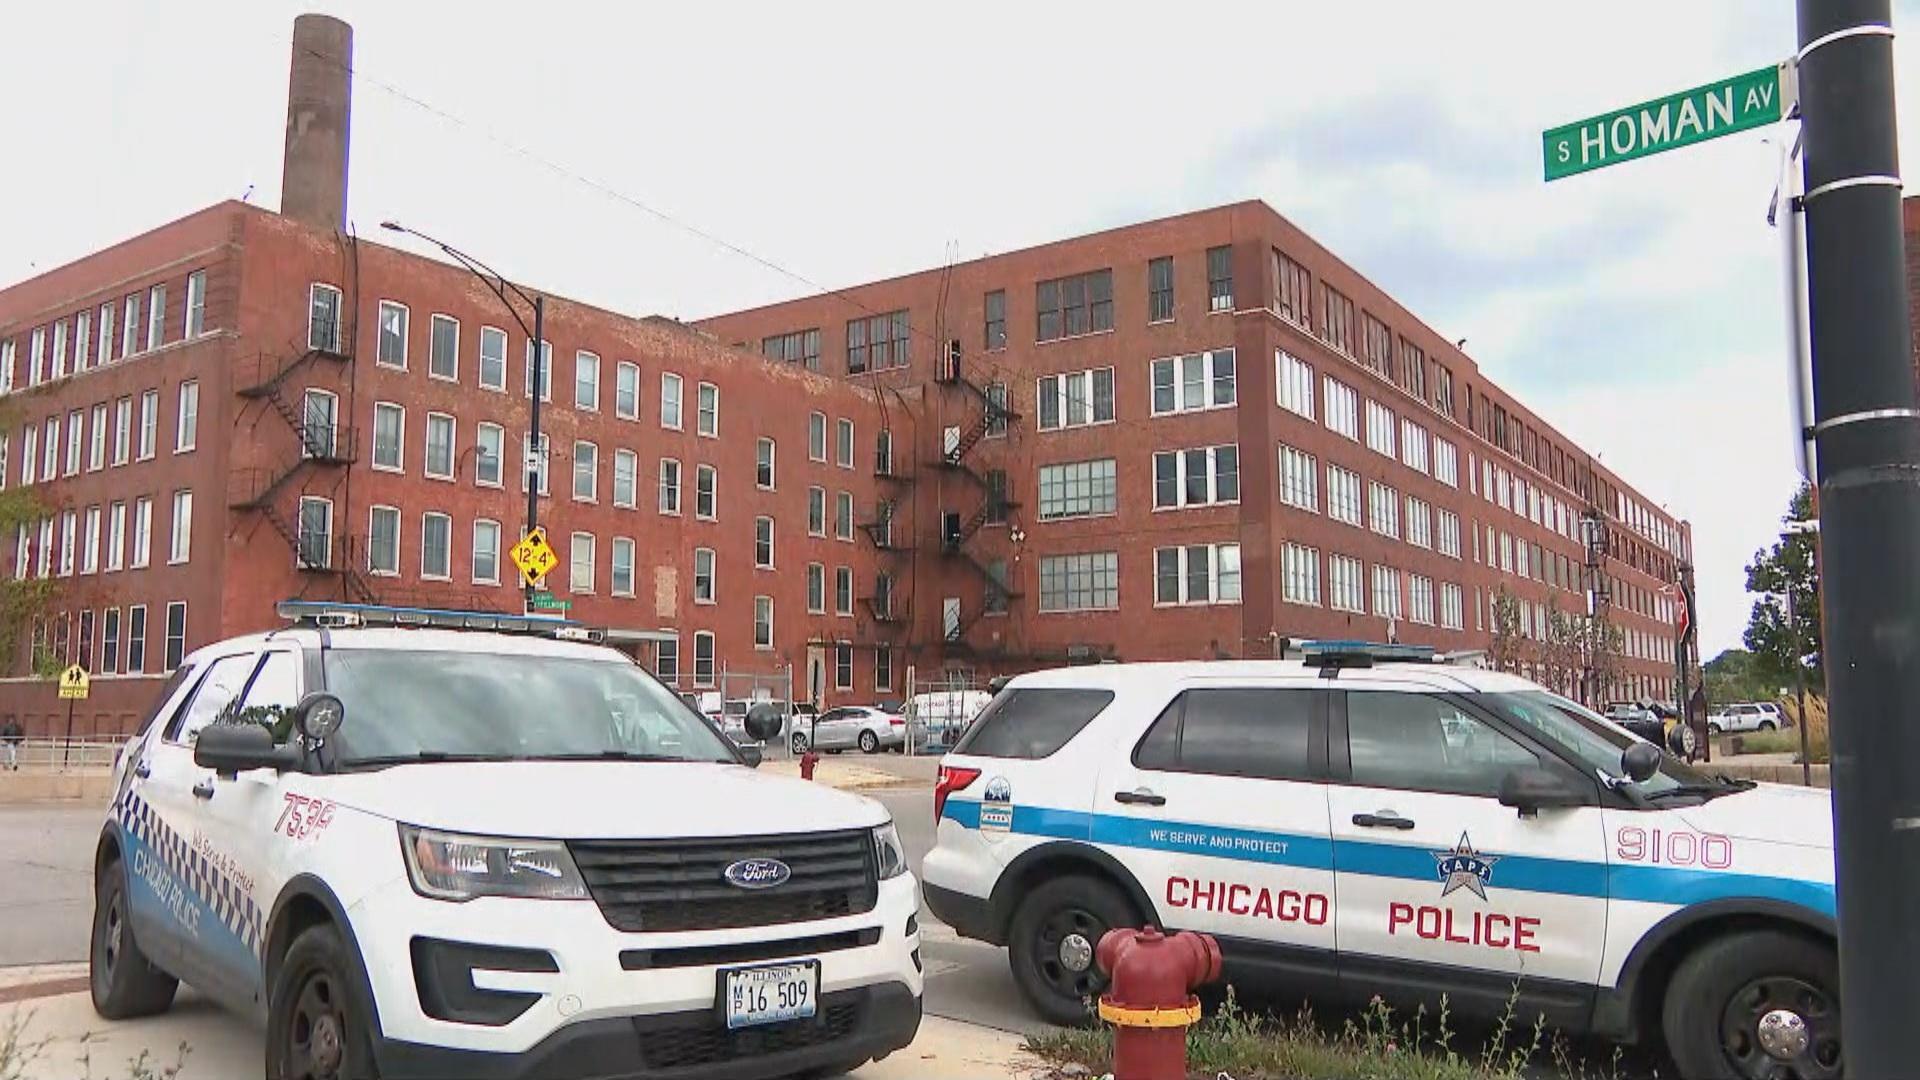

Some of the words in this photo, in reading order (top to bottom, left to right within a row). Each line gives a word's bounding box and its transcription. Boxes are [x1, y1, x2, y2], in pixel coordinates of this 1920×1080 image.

[1558, 141, 1570, 163] S
[1581, 86, 1735, 164] HOMAN
[1744, 82, 1775, 114] AV
[1150, 829, 1168, 842] WE
[1169, 831, 1207, 846] SERVE
[1209, 835, 1233, 849] AND
[1234, 838, 1289, 855] PROTECT
[1617, 826, 1732, 869] 9100
[742, 862, 780, 881] Ford
[1442, 859, 1488, 877] CAPS
[134, 848, 172, 904] CHICAGO
[167, 882, 201, 938] POLICE
[1166, 876, 1329, 926] CHICAGO
[1388, 902, 1541, 953] POLICE
[752, 970, 793, 983] ILLINOIS
[747, 986, 767, 1013] 16
[778, 980, 808, 1009] 509
